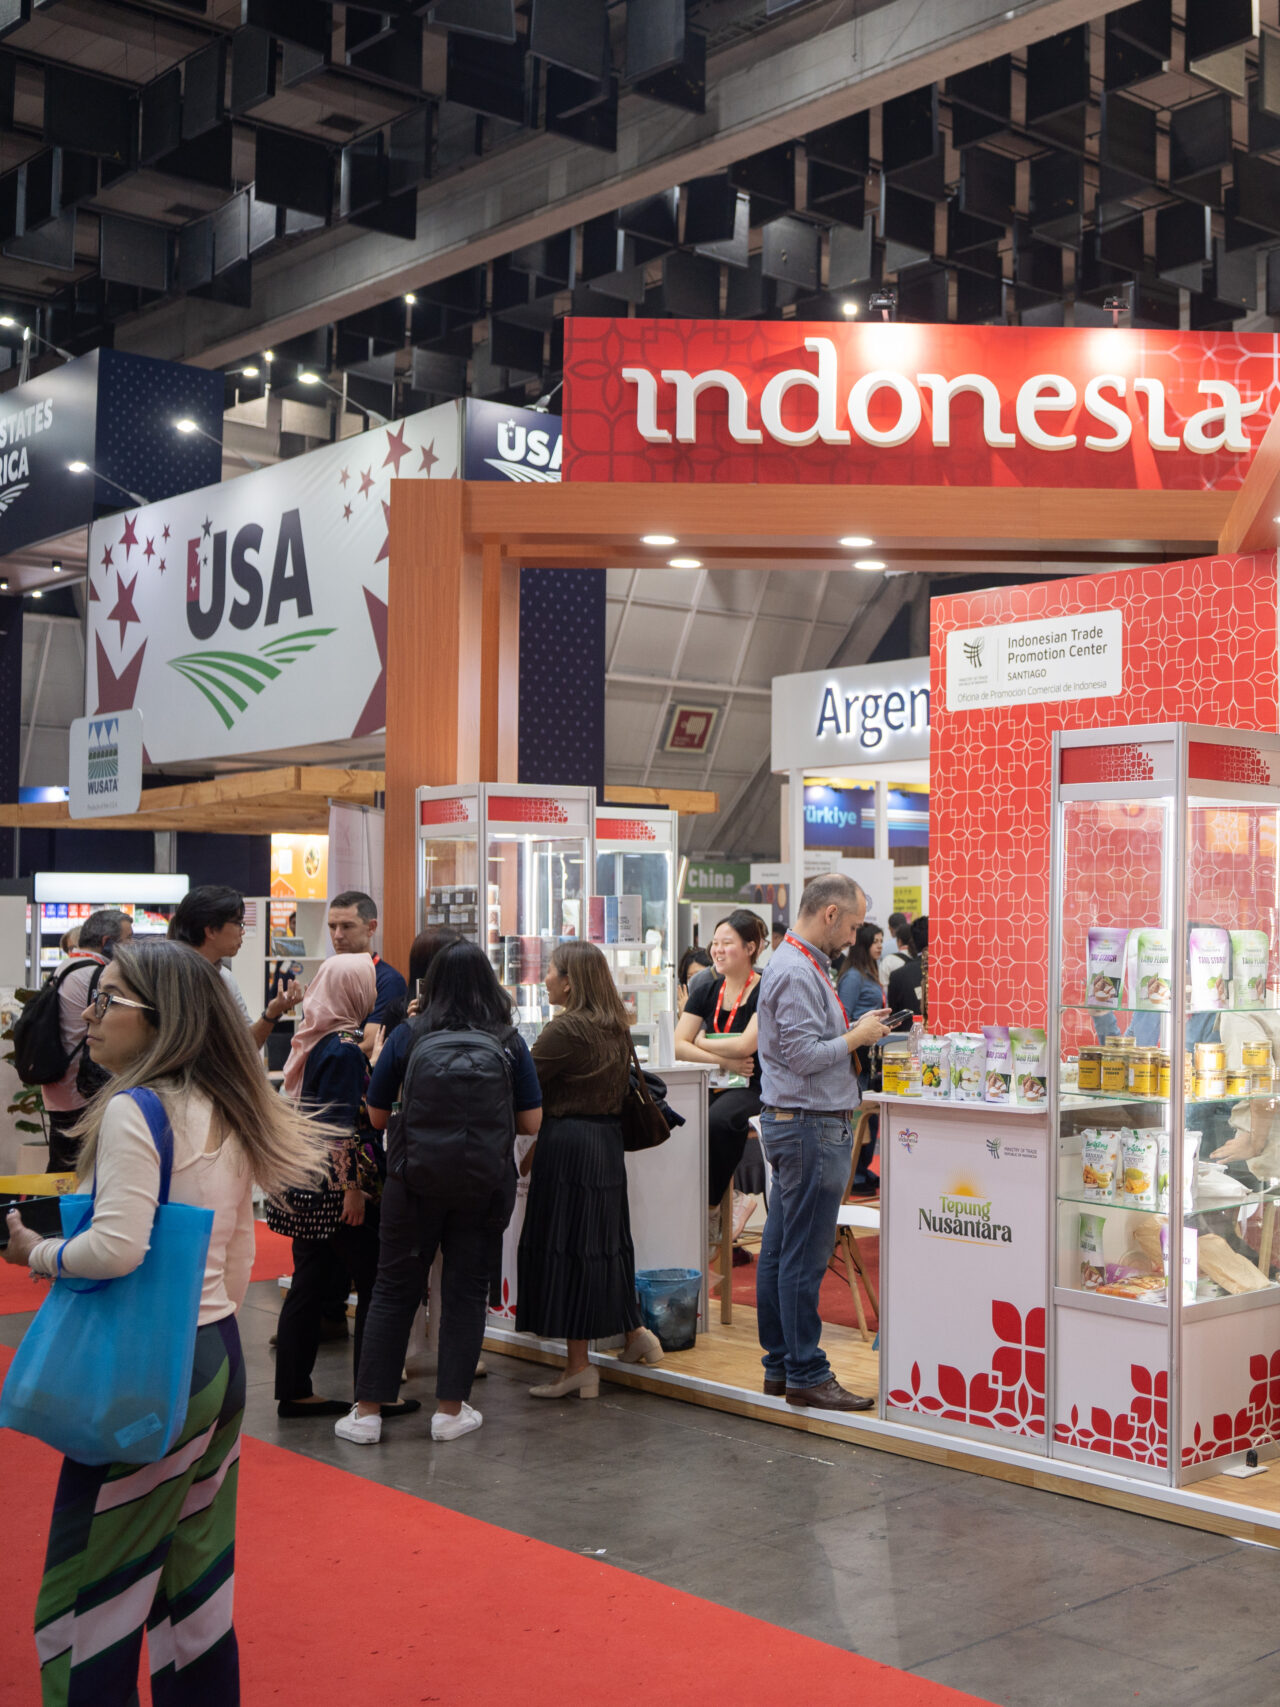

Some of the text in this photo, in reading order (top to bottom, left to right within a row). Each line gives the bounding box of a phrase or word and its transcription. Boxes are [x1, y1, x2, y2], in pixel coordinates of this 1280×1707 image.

[622, 337, 1263, 453] indonesia
[186, 507, 314, 641] USA
[1007, 625, 1104, 649] Indonesian Trade
[1007, 643, 1108, 664] Promotion Center
[1007, 668, 1047, 681] SANTIAGO
[957, 690, 980, 703] Oficina
[980, 690, 990, 700] de
[1027, 682, 1062, 696] Comercial
[1062, 682, 1072, 692] de
[1073, 679, 1107, 691] Indonesia
[87, 779, 118, 796] WUSATA
[687, 868, 735, 889] China
[939, 1195, 993, 1222] Tepung
[918, 1207, 1013, 1243] Nusantara
